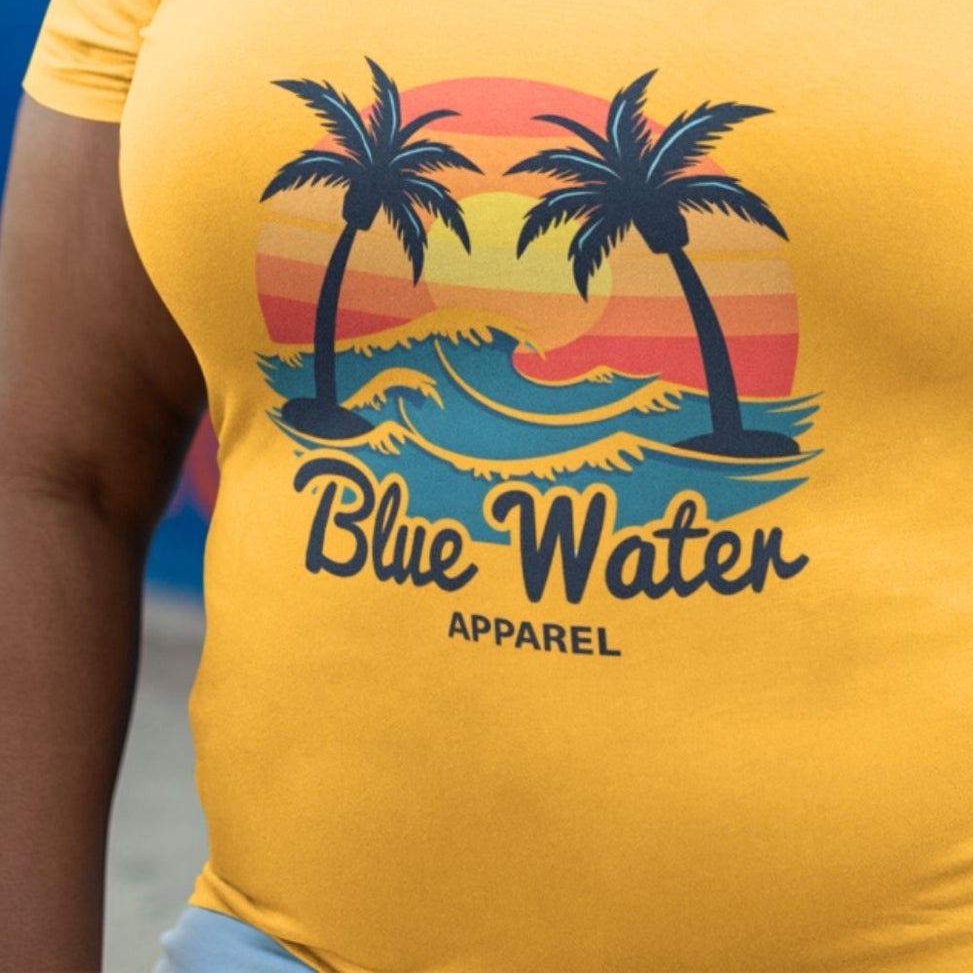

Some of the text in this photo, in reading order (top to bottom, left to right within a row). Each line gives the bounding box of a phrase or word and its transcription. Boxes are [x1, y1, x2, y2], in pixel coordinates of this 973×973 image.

[293, 458, 808, 604] Blue Water
[448, 611, 622, 657] APPAREL
